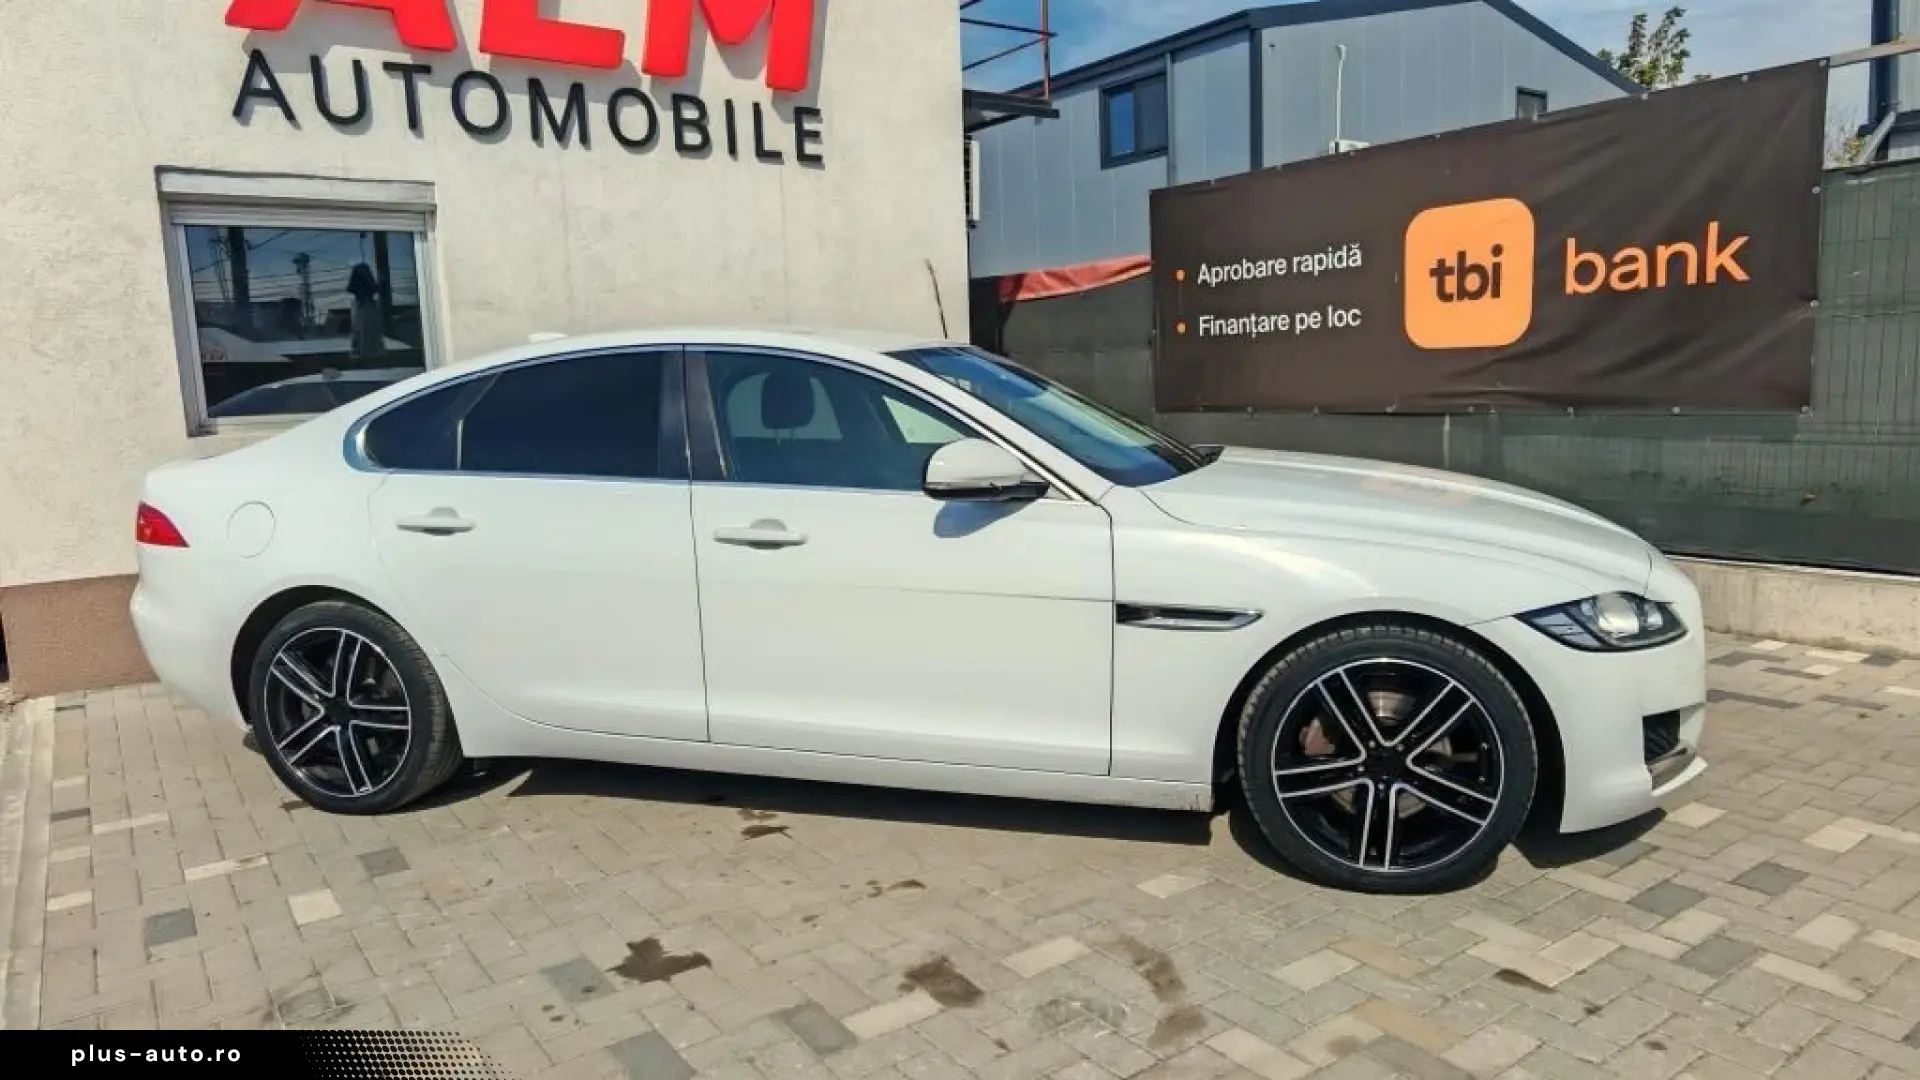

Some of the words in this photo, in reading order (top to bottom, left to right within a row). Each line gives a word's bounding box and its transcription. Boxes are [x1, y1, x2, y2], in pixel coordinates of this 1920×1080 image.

[232, 48, 823, 162] AUTOMOBILE
[1197, 258, 1287, 288] Aprobare
[1292, 243, 1363, 276] rapidă
[1429, 243, 1504, 303] tbi
[1564, 220, 1751, 296] bank
[1199, 312, 1291, 338] Finanțare
[1295, 310, 1322, 335] pe
[1327, 304, 1363, 329] loc
